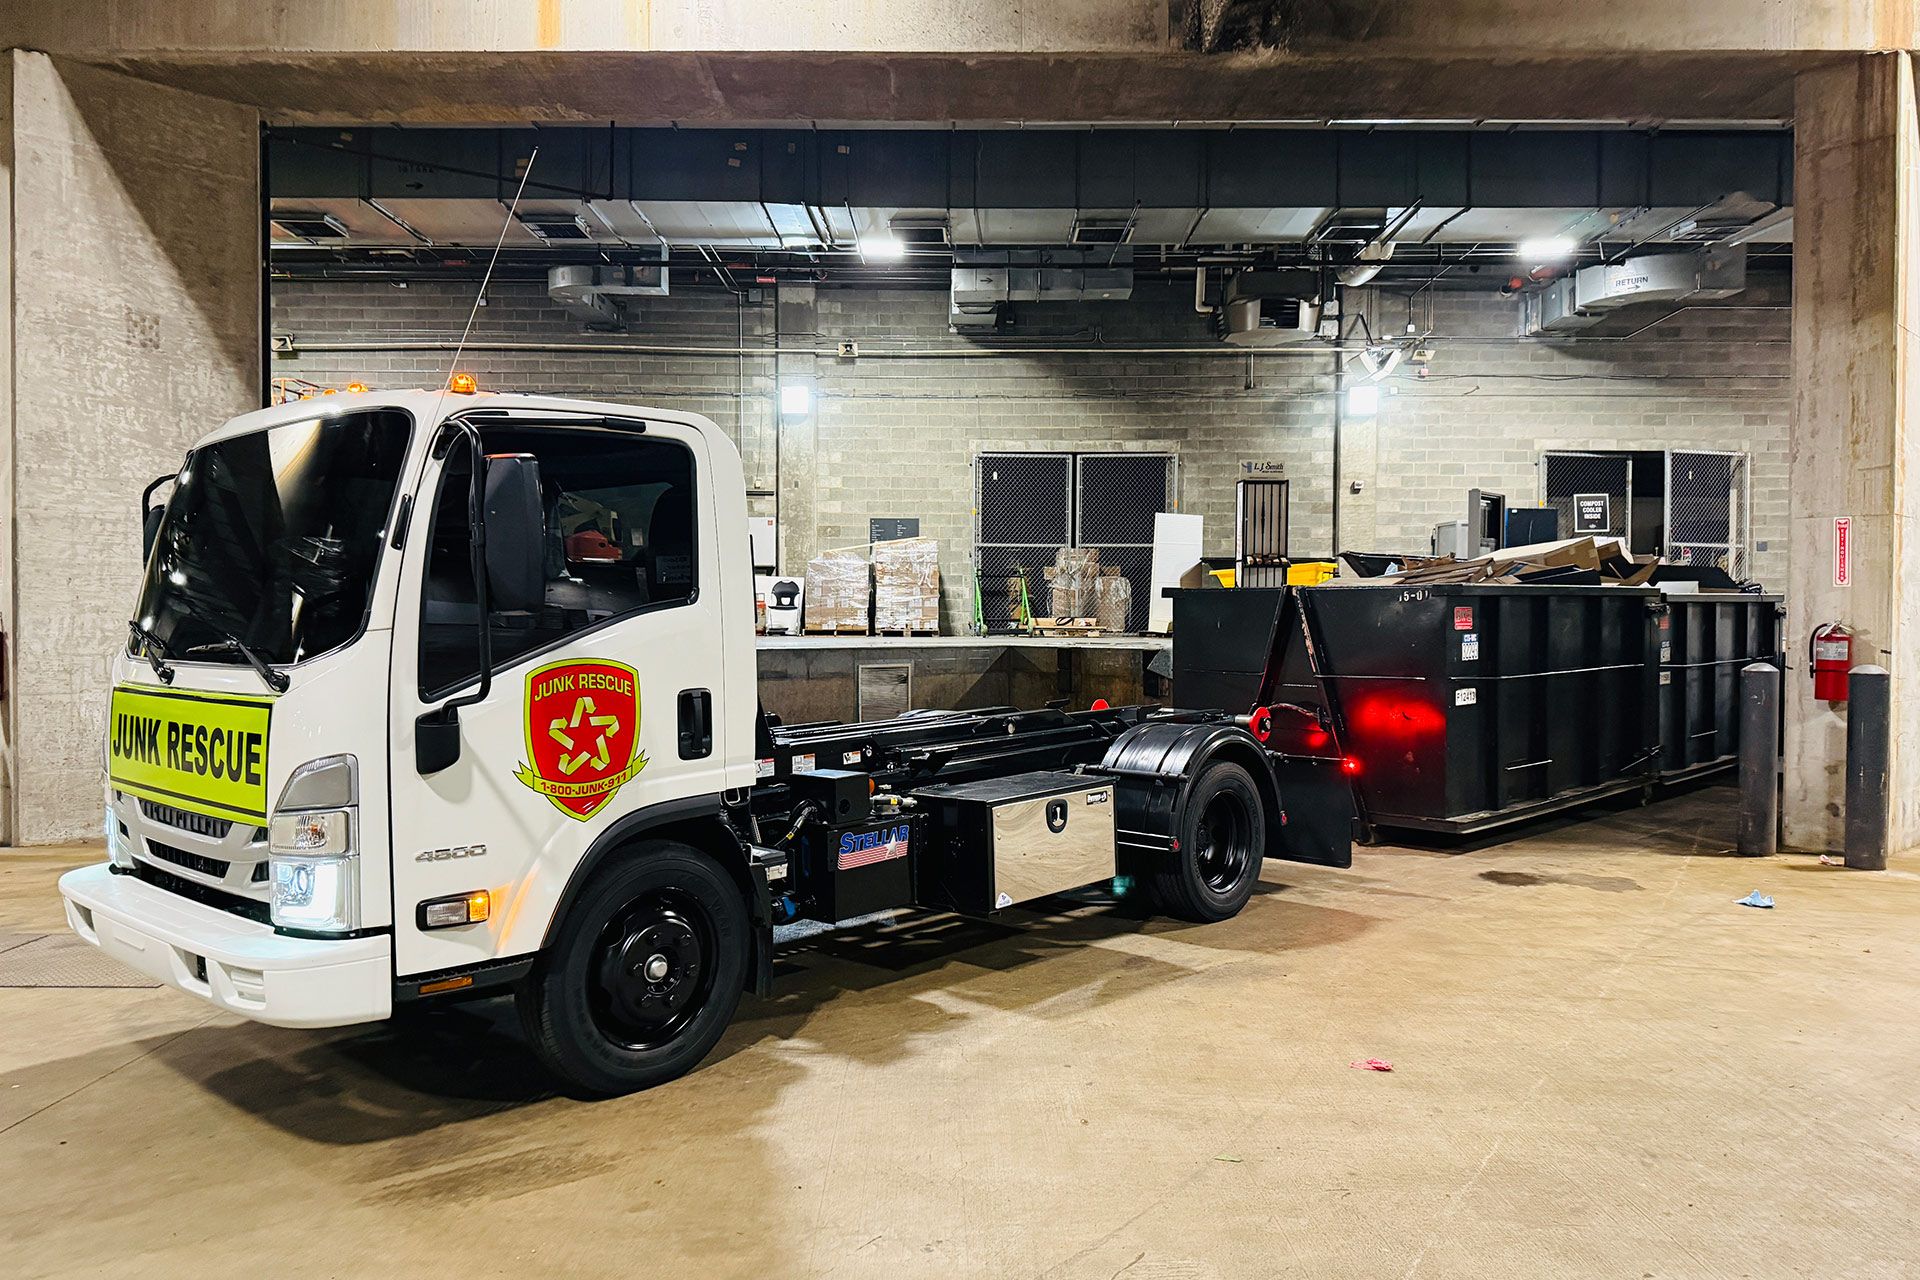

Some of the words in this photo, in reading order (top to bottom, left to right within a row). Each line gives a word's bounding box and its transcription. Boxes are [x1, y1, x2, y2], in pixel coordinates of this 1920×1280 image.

[1615, 276, 1649, 287] RETURN
[1265, 461, 1284, 471] Smith
[535, 674, 575, 702] JUNK
[579, 673, 632, 697] RESCUE
[113, 713, 162, 766] JUNK
[167, 721, 262, 786] RESCUE
[540, 772, 628, 796] 1-800-JUNK-911
[839, 824, 910, 855] STELLAR
[415, 844, 487, 863] 4500
